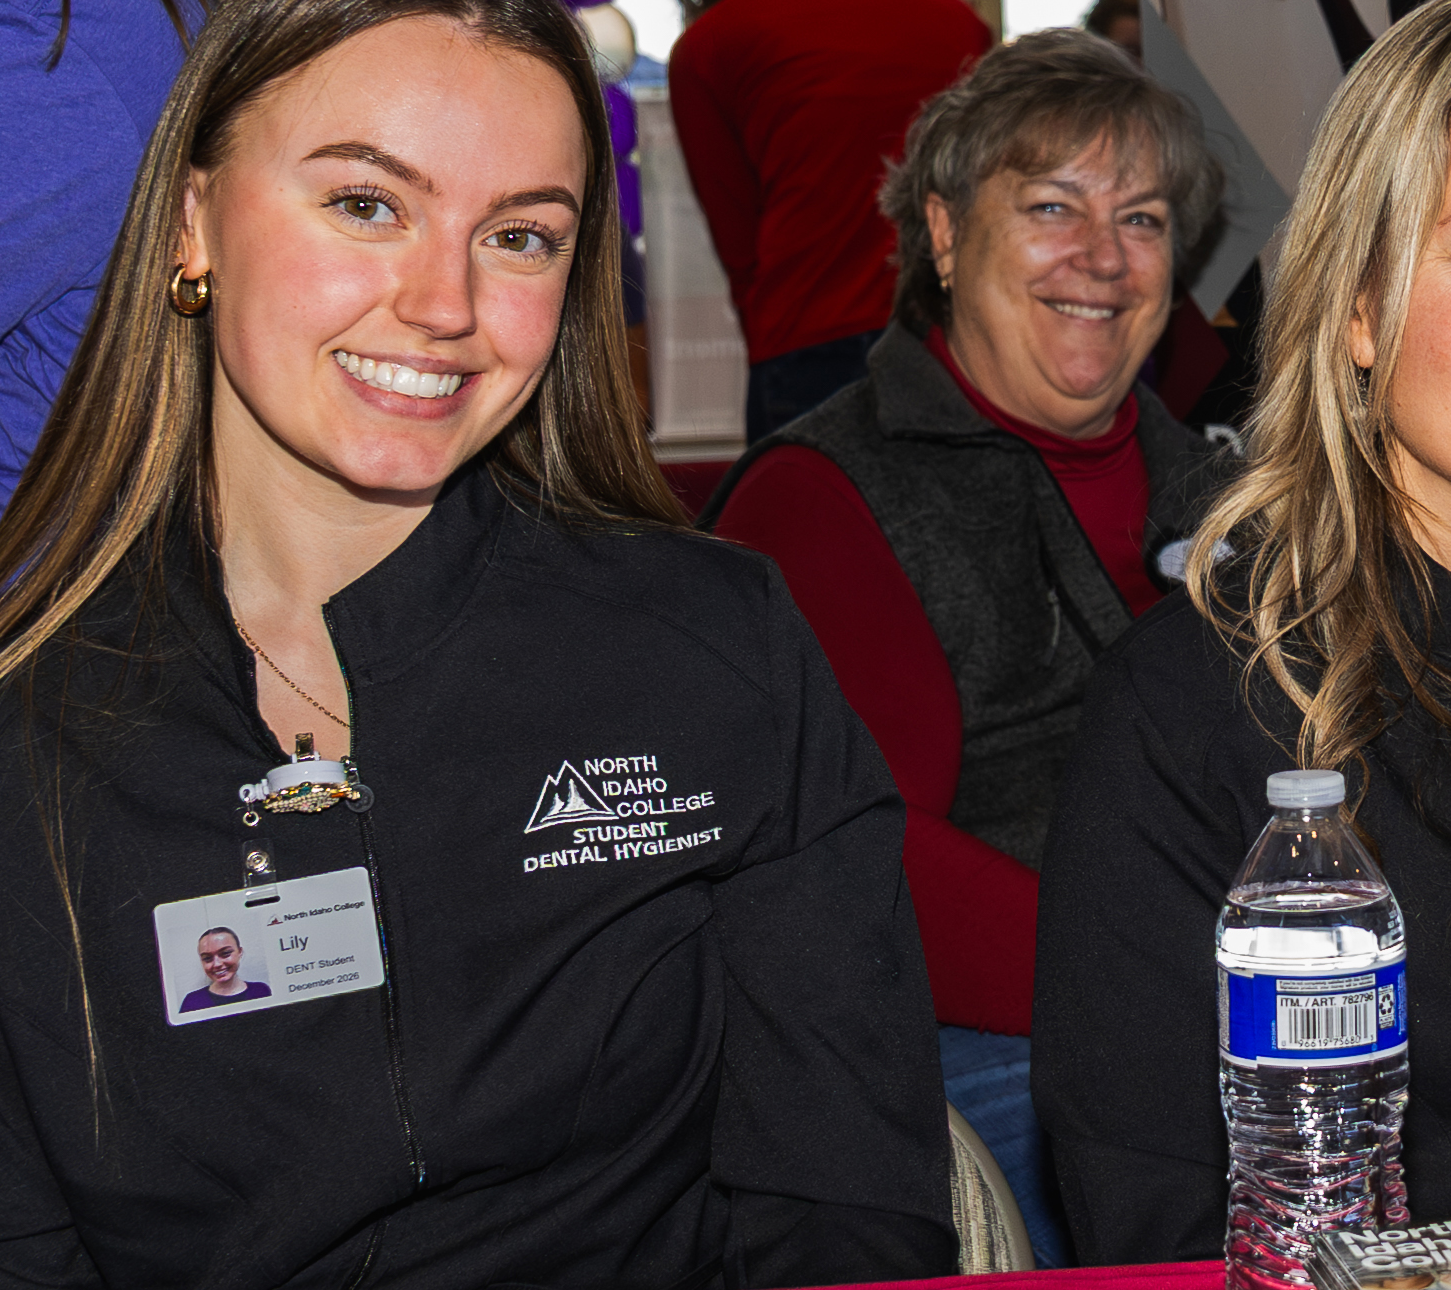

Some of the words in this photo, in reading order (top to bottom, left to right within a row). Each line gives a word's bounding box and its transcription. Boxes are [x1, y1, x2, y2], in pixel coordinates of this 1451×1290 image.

[584, 755, 658, 776] NORTH
[602, 778, 668, 796] IDAHO
[617, 791, 715, 817] COLLEGE
[573, 821, 668, 844] STUDENT
[524, 845, 608, 872] DENTAL
[614, 827, 723, 860] HYGIENIST
[284, 911, 308, 921] North
[309, 906, 333, 916] Idaho
[333, 901, 365, 912] College
[279, 935, 309, 951] Lily
[286, 962, 315, 975] DENT
[318, 955, 356, 968] Student
[289, 977, 334, 992] December
[337, 972, 360, 983] 2026
[1280, 997, 1302, 1007] ITM.
[1311, 996, 1336, 1007] ART.
